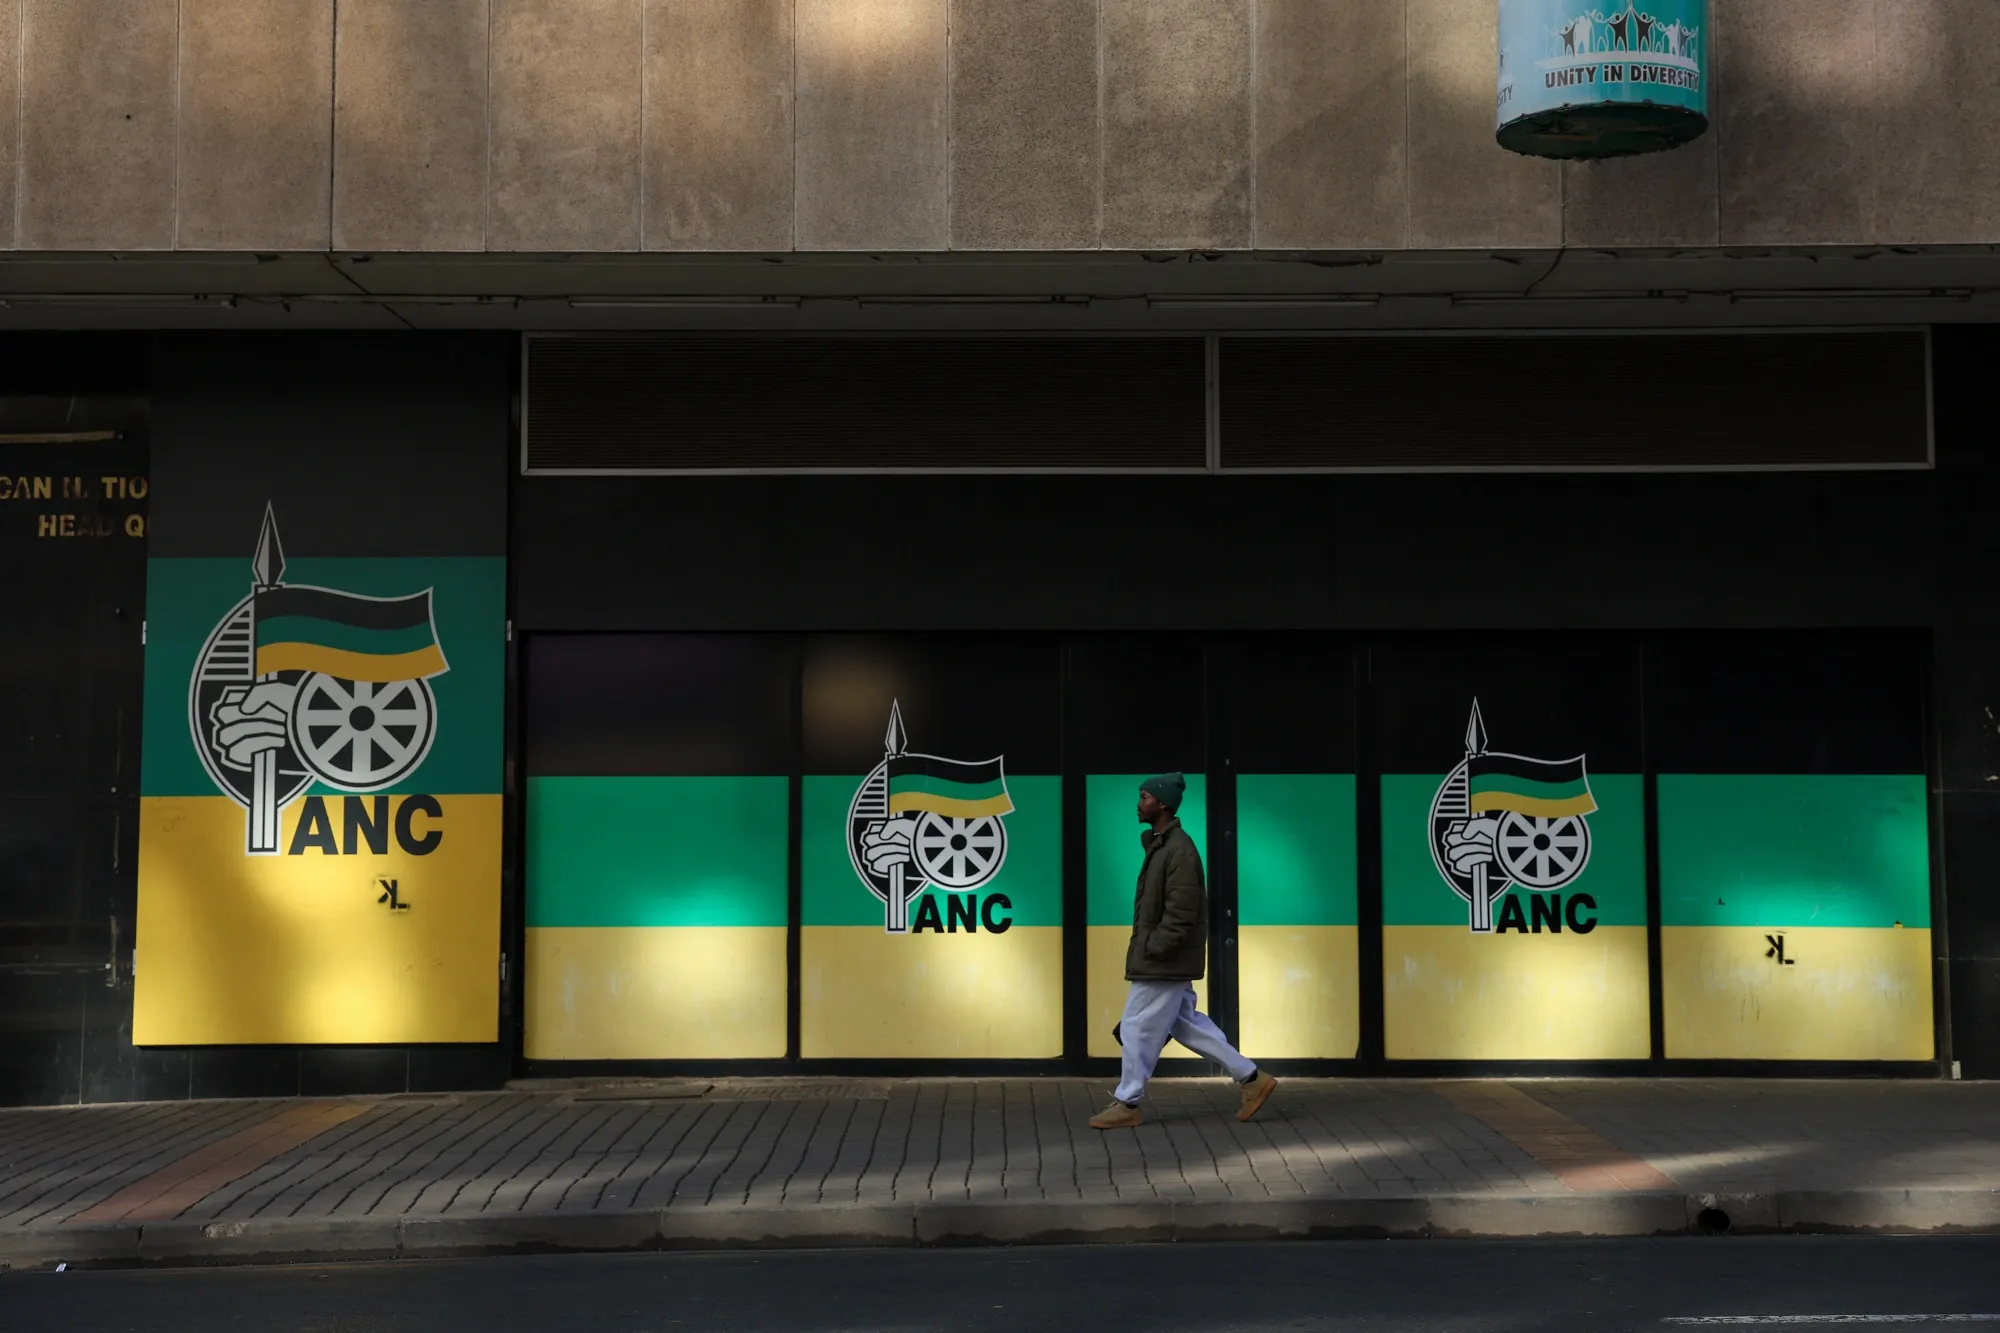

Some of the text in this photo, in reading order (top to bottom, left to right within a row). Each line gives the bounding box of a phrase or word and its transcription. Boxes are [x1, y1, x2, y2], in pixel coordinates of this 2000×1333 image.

[288, 794, 443, 856] ANC
[912, 893, 1013, 934] ANC
[1496, 893, 1598, 934] ANC
